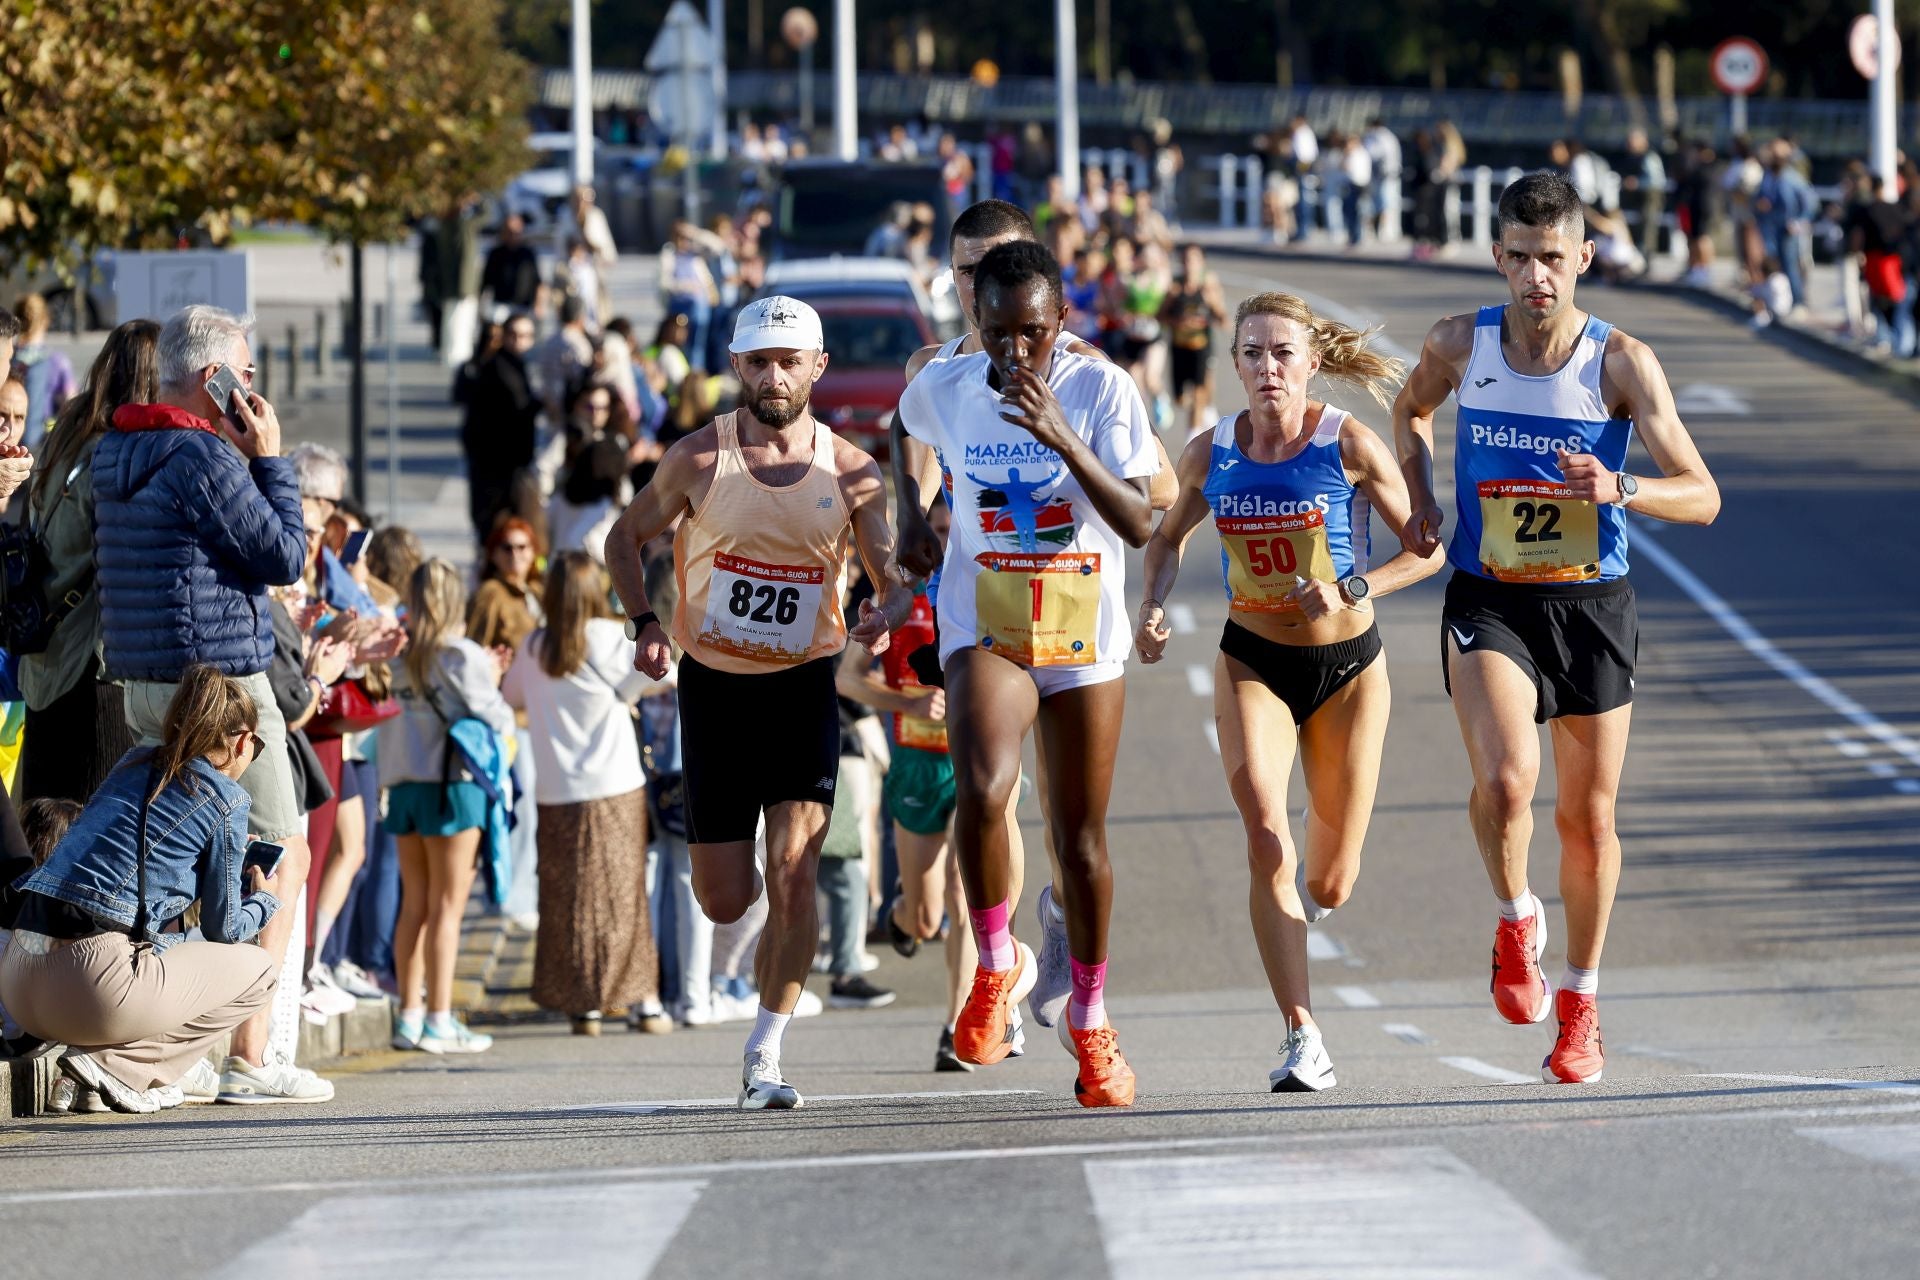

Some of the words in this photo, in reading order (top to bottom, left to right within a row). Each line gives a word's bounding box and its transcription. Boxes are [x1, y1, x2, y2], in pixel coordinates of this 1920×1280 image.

[964, 458, 987, 466] PURA
[989, 457, 1028, 466] LECCIÓN
[1511, 485, 1535, 493] MBA
[1242, 522, 1264, 531] MBA
[1513, 501, 1562, 543] 22
[1010, 559, 1035, 568] MBA
[1246, 537, 1297, 577] 50
[747, 565, 770, 576] MBA
[786, 570, 809, 579] GIJÓN
[728, 579, 800, 625] 826
[1028, 578, 1043, 622] 1
